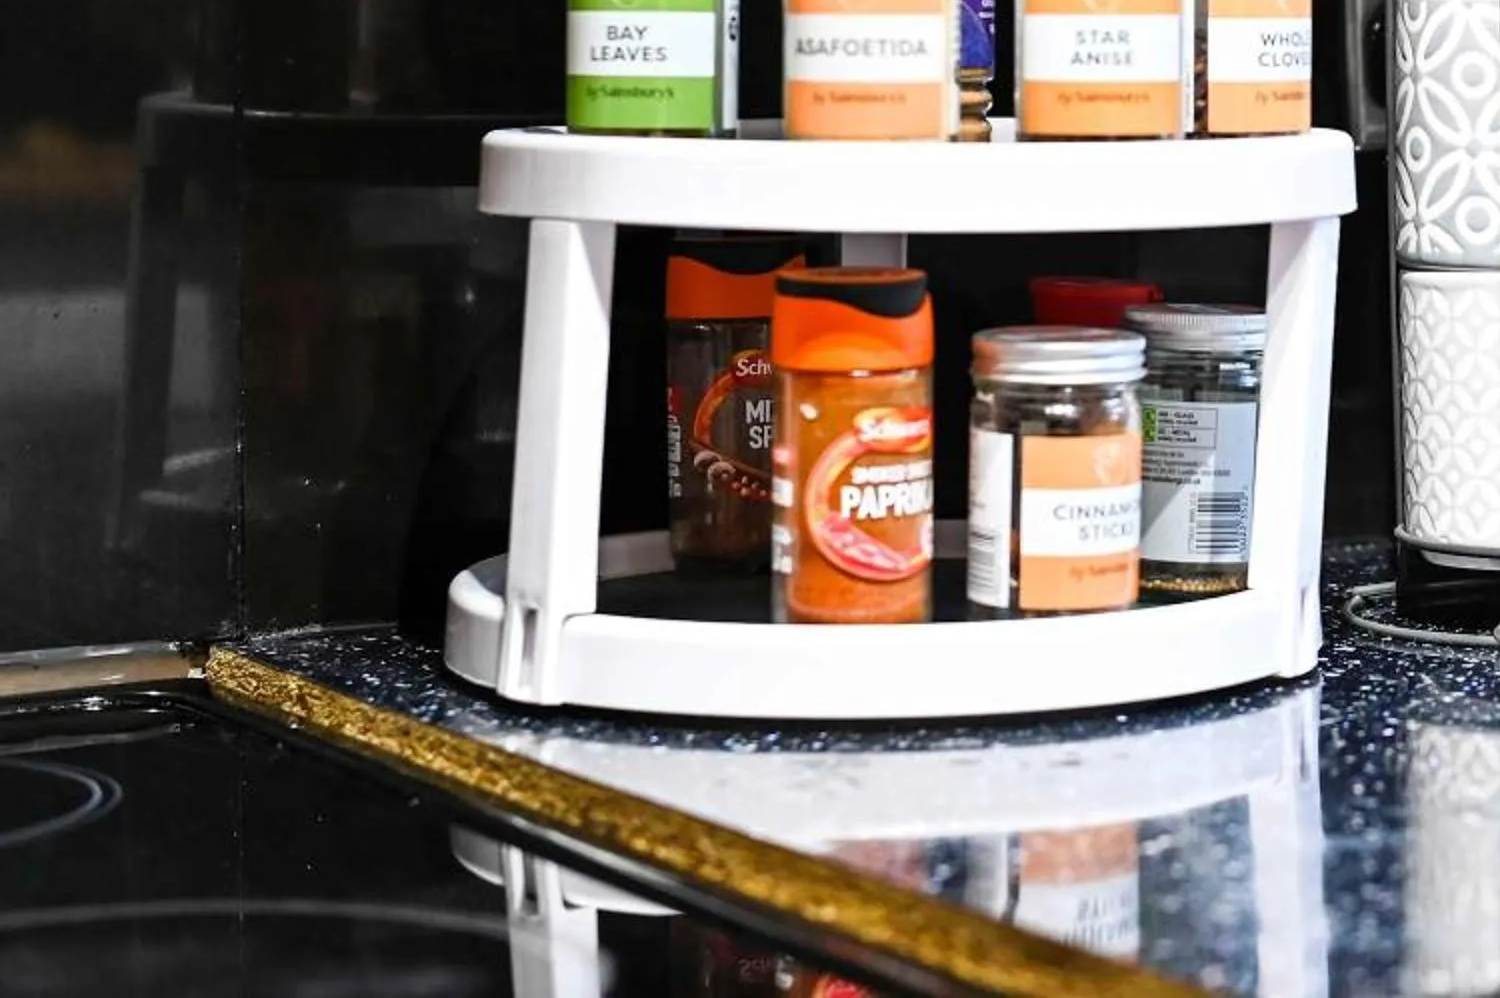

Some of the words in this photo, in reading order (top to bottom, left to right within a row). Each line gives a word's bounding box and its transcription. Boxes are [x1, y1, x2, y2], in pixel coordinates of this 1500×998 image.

[607, 25, 648, 41] BAY
[1075, 29, 1130, 45] STAR
[590, 46, 668, 62] LEAVES
[795, 37, 928, 57] ASAFOETIDA
[1070, 50, 1134, 66] ANISE
